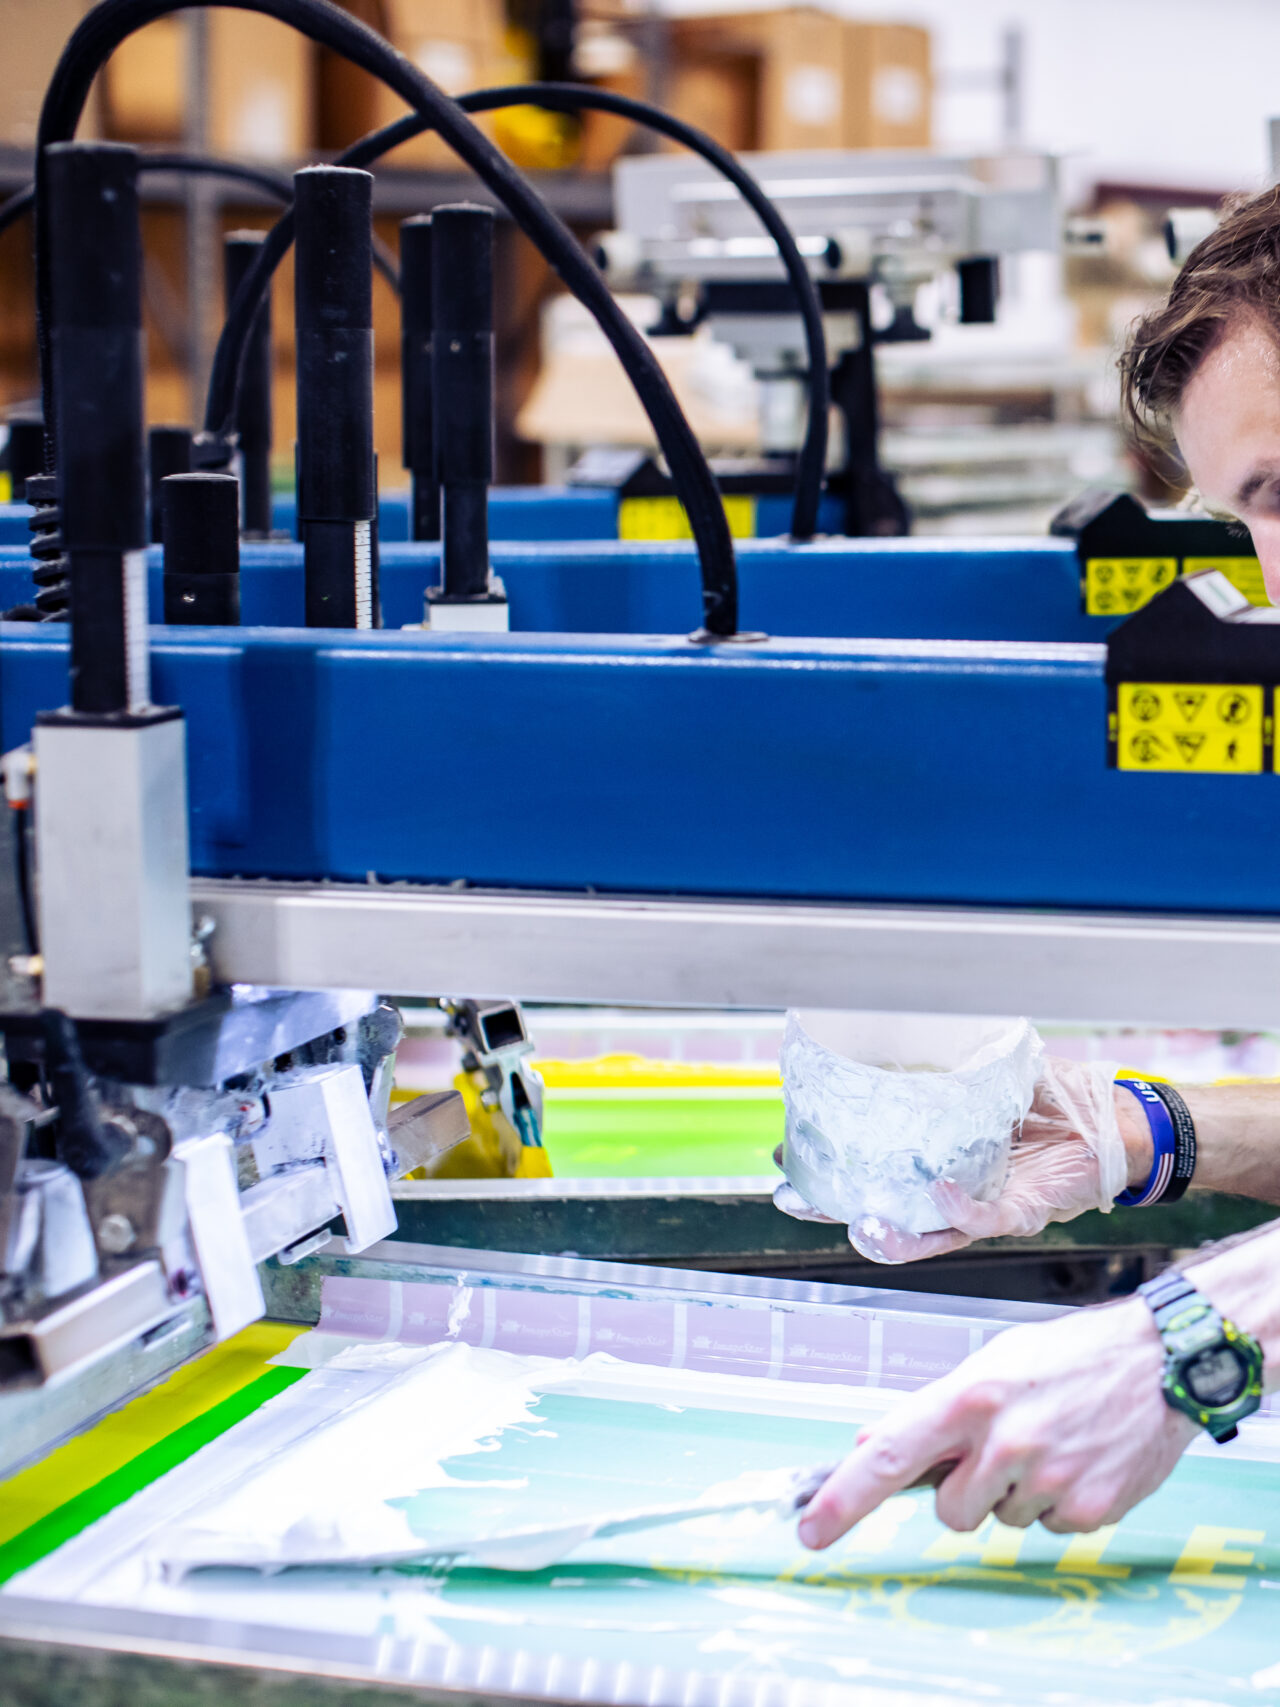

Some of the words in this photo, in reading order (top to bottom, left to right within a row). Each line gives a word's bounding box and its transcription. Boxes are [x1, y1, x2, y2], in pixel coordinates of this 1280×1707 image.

[1127, 1078, 1161, 1103] US
[713, 1341, 766, 1354] ImageStar
[809, 1348, 863, 1363] ImageStar
